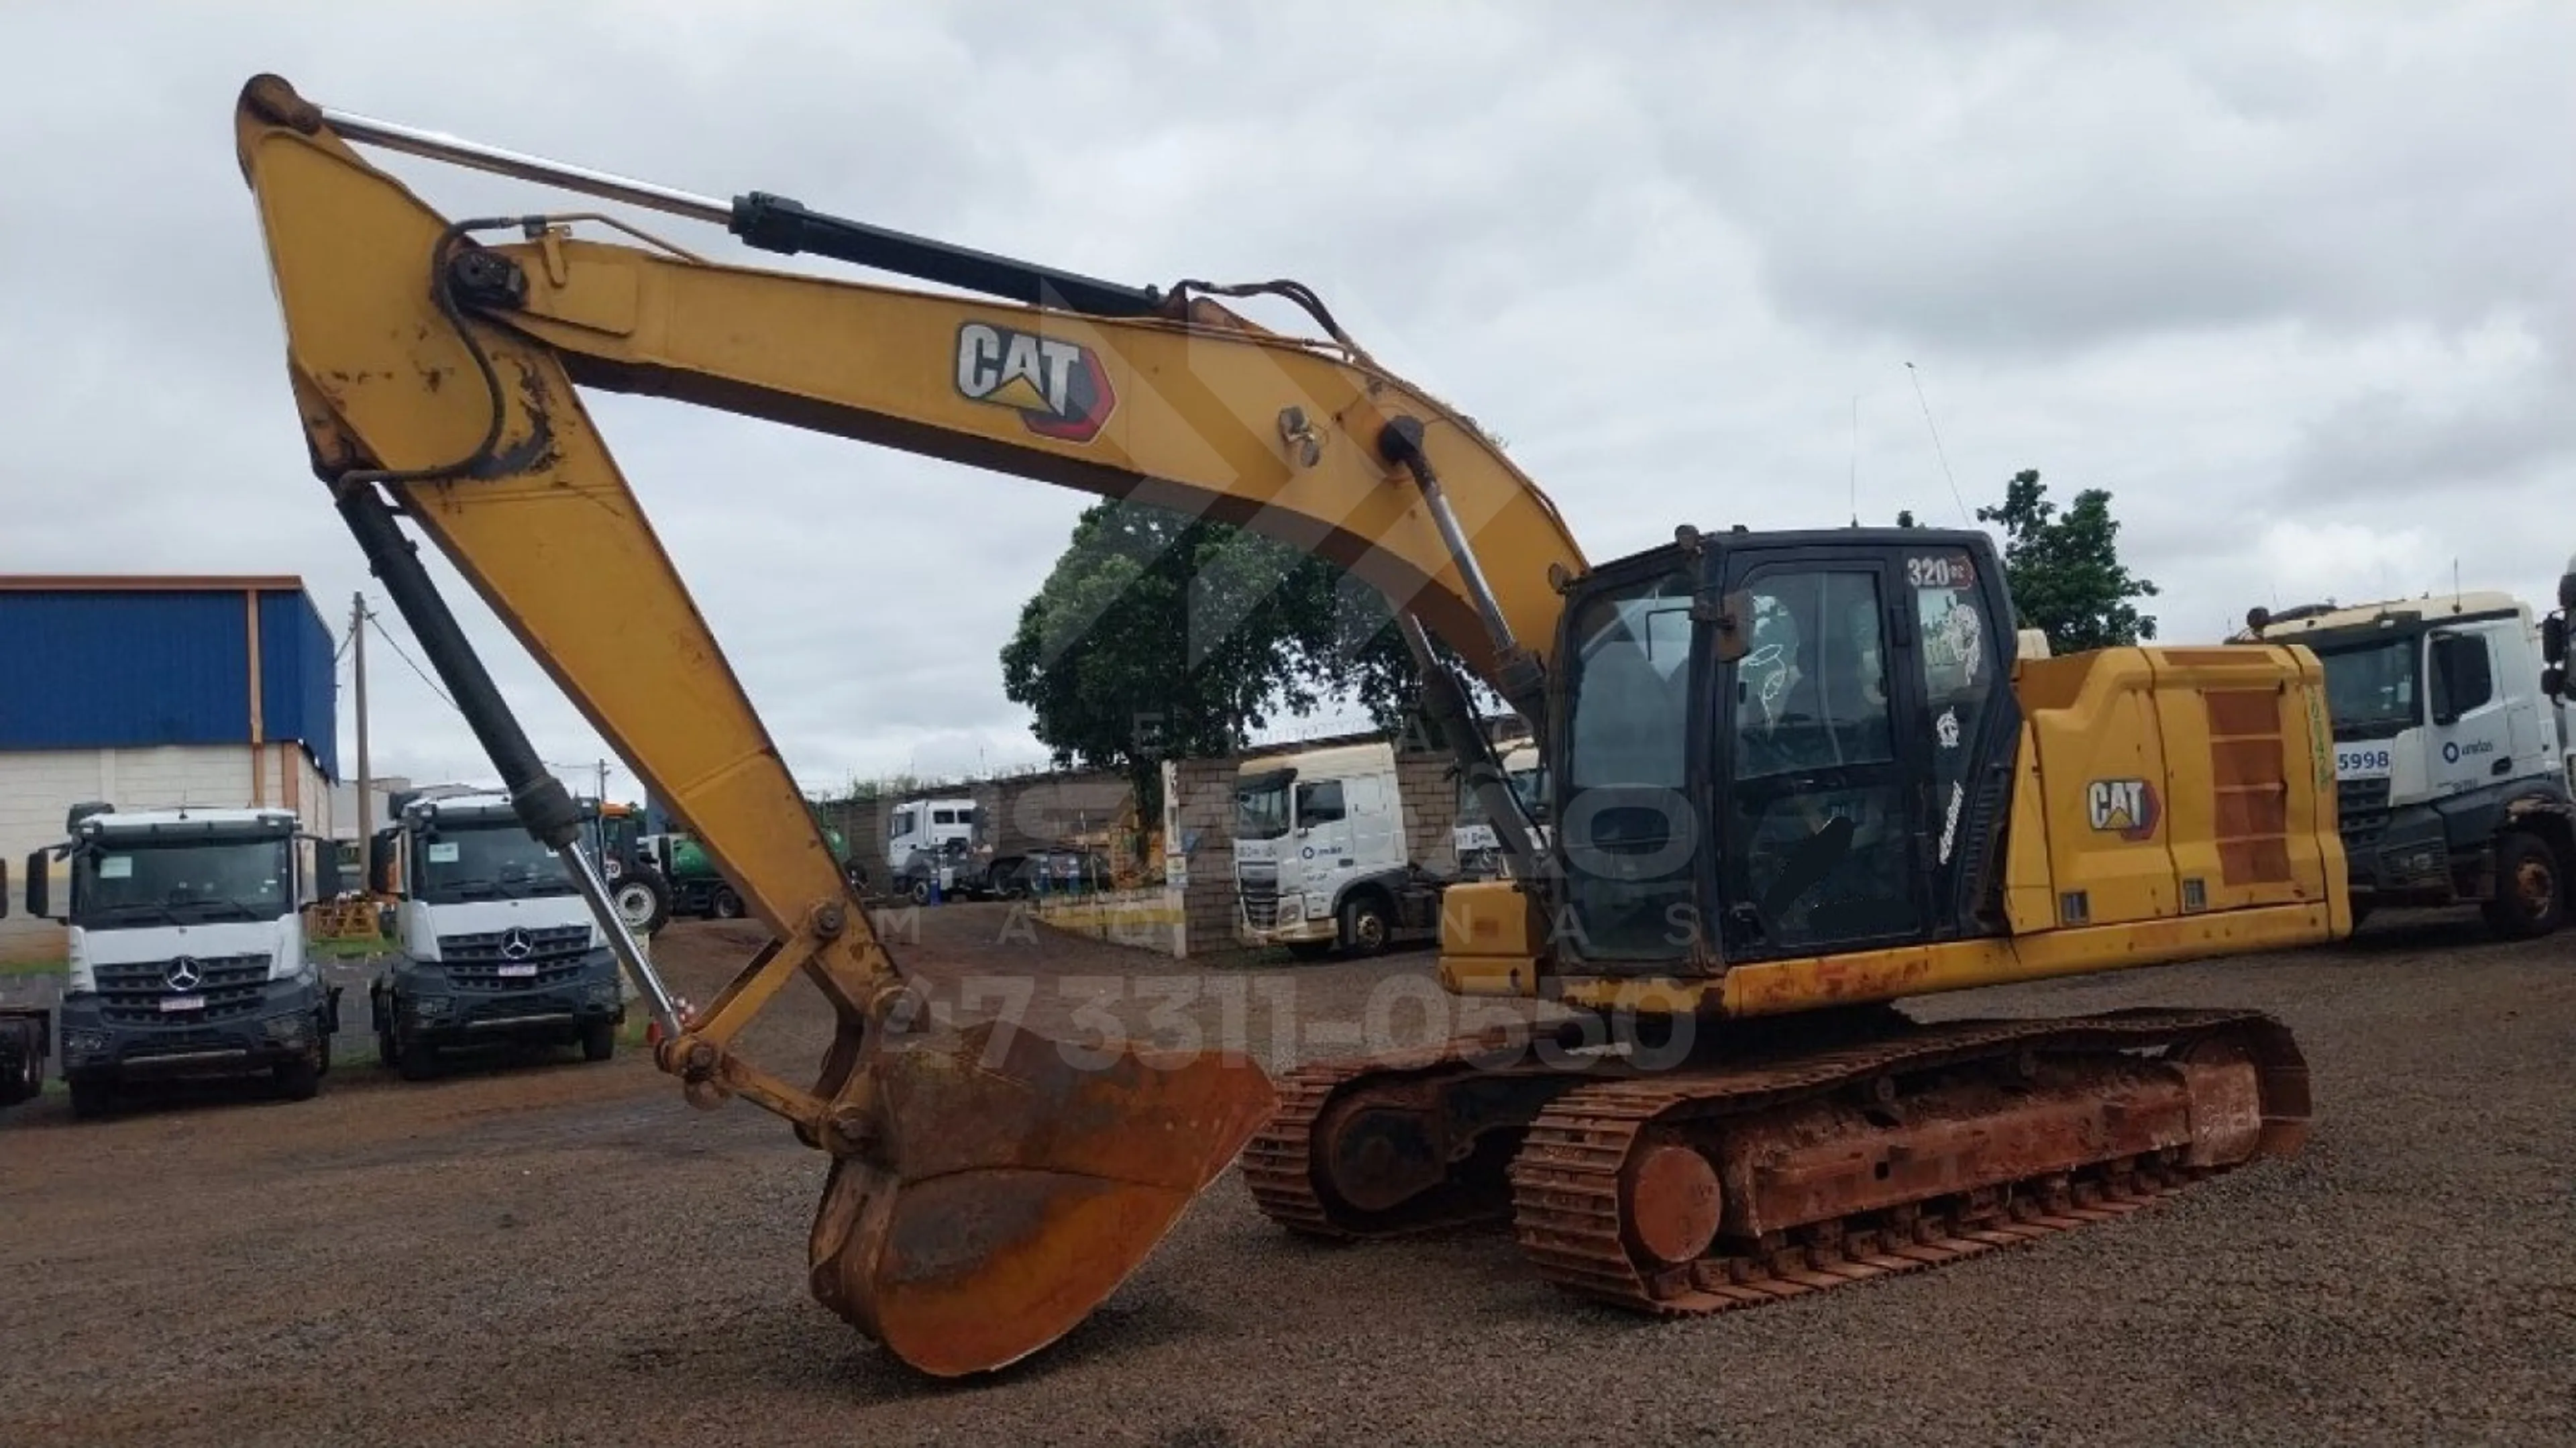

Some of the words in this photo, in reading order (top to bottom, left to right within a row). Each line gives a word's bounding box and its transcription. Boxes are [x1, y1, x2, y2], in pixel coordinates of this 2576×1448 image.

[957, 323, 1080, 416] CAT
[1907, 557, 1949, 586] 320
[2338, 751, 2389, 771] 5998
[2089, 782, 2143, 829] CAT
